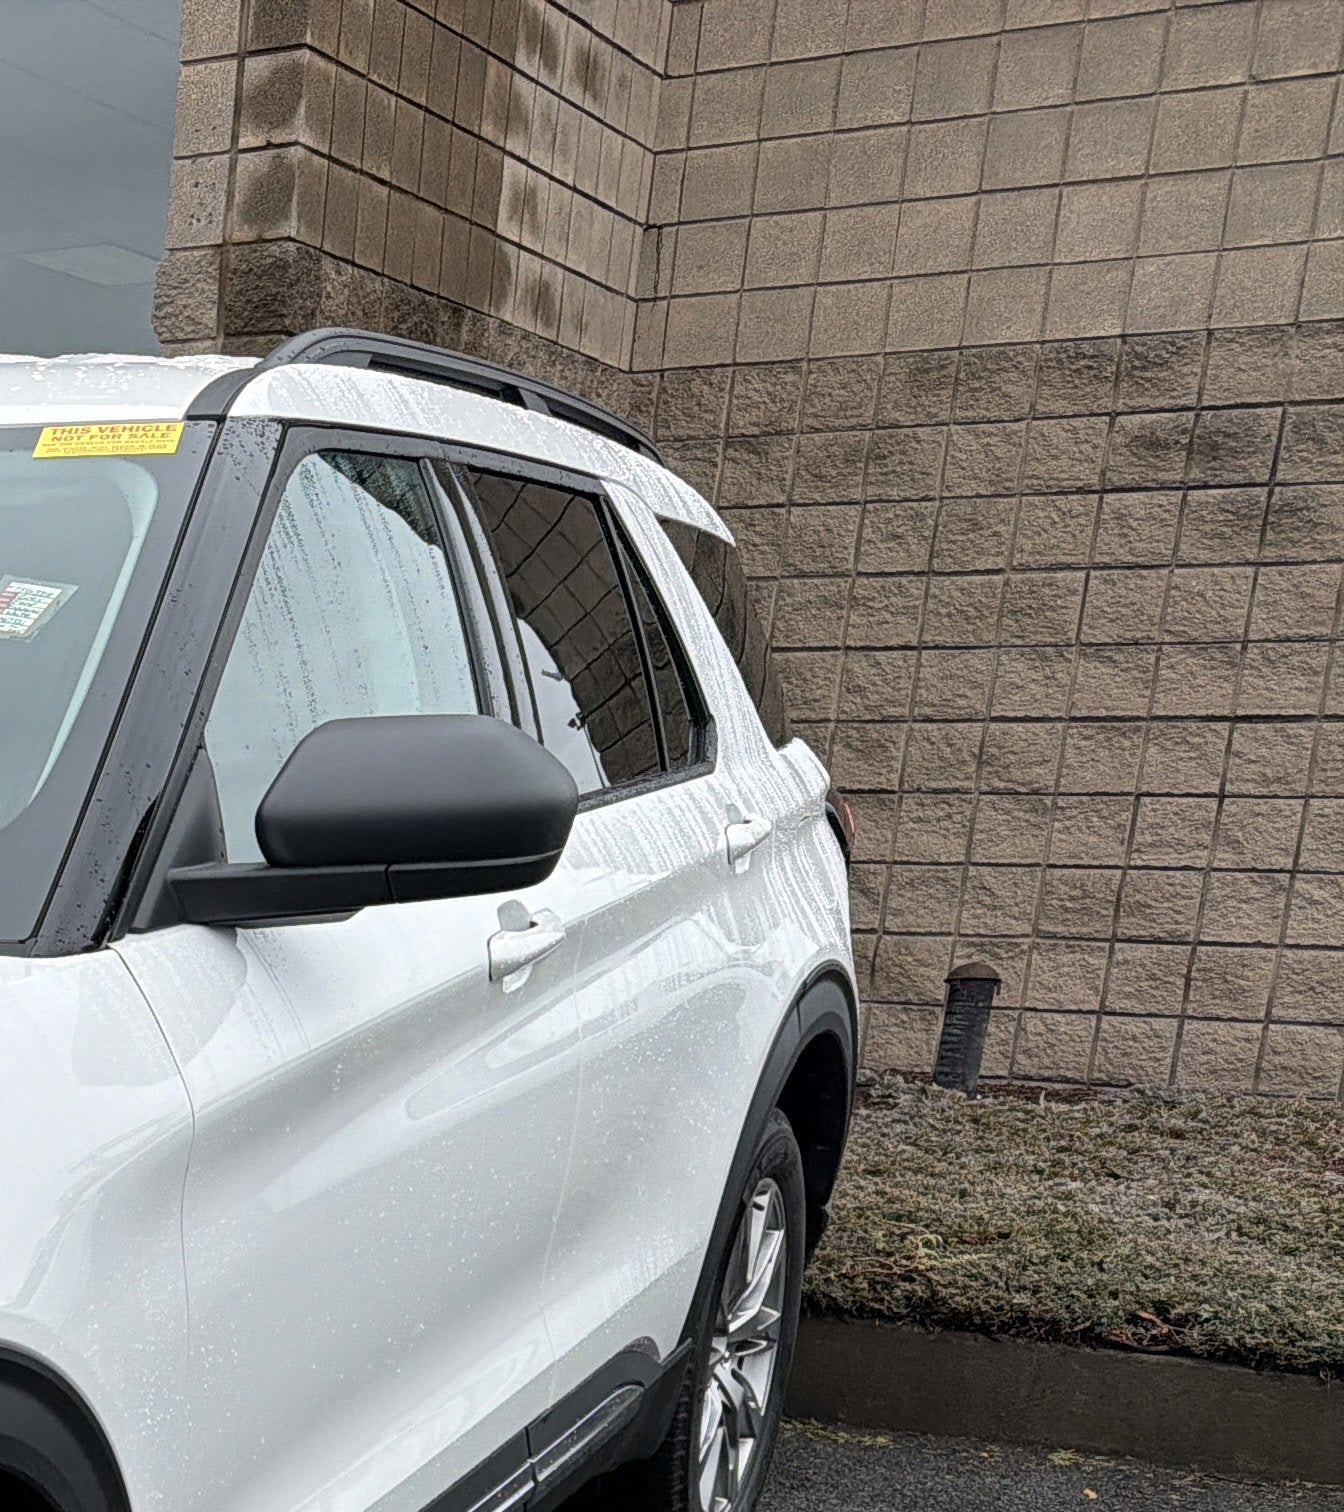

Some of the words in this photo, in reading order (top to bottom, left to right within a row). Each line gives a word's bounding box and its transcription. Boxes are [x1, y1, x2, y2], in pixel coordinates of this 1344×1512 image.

[50, 426, 92, 436] THIS
[97, 424, 177, 434] VEHICLE
[51, 434, 85, 442] NOT
[89, 433, 122, 441] FOR
